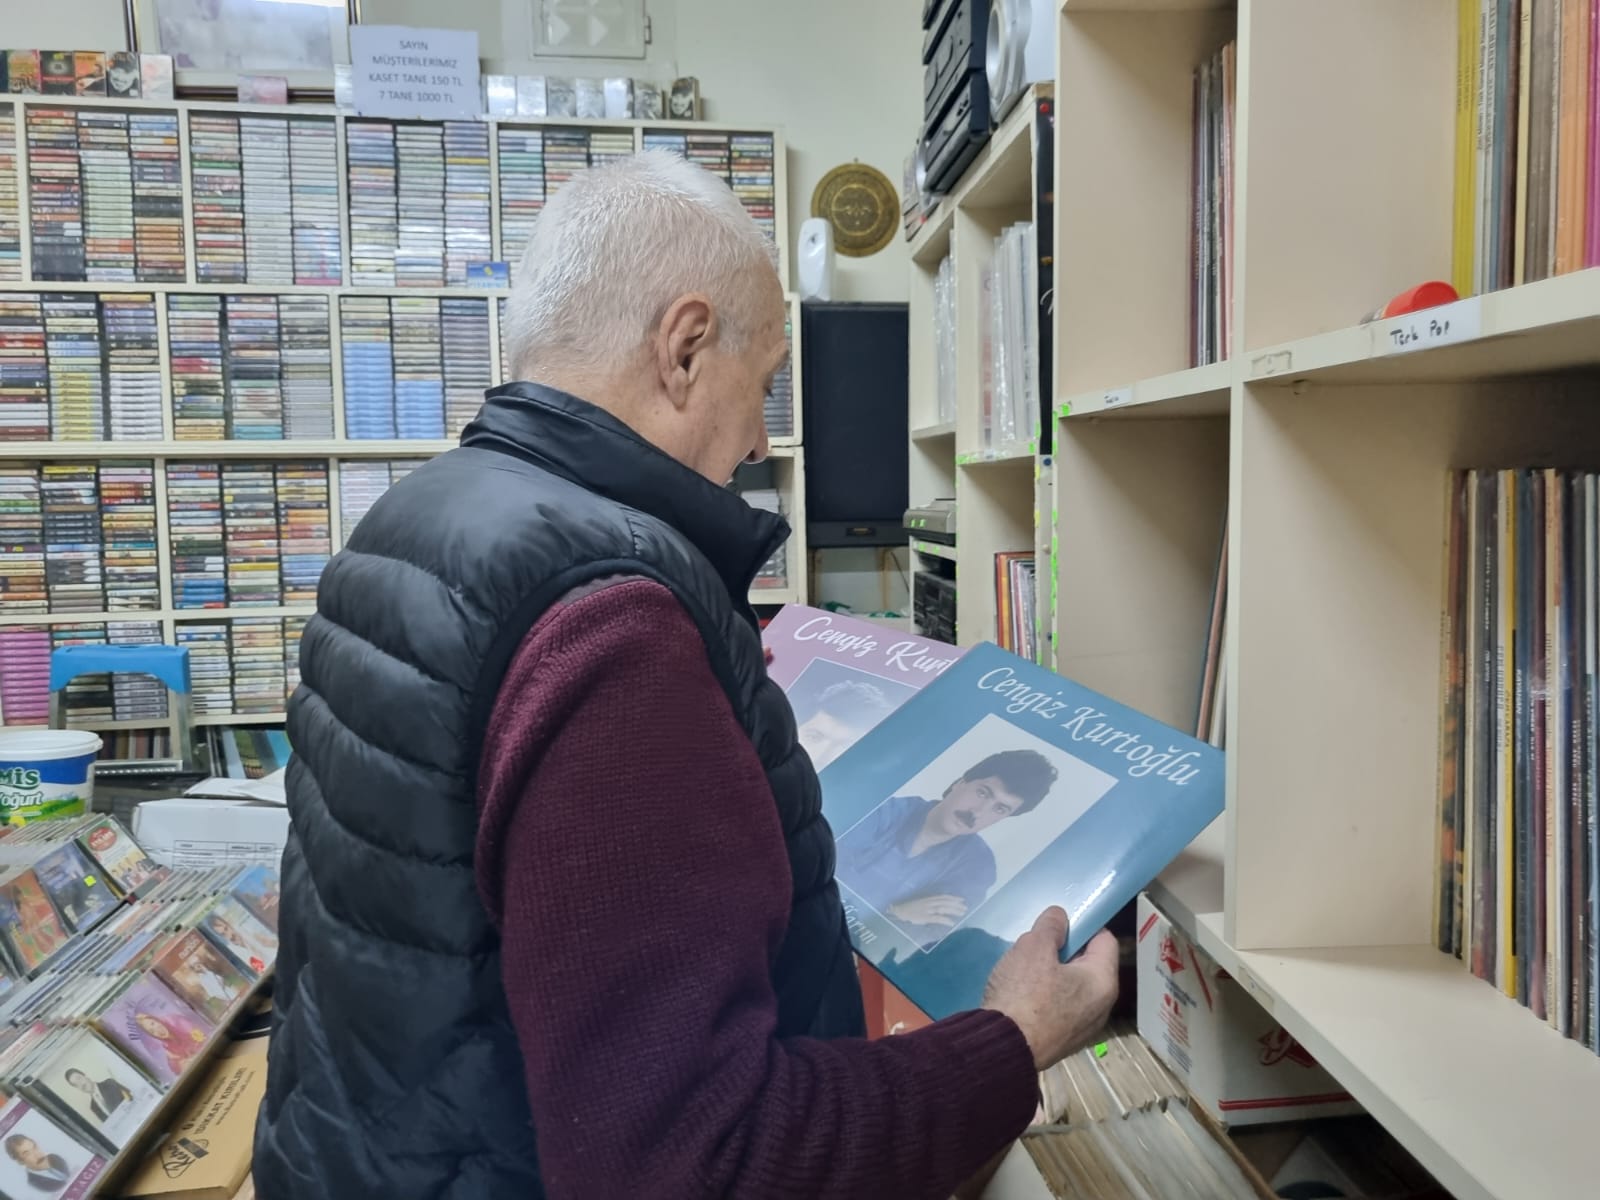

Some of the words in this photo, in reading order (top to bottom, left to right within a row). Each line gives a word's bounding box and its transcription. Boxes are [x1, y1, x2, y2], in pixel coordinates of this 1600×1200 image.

[399, 40, 429, 51] SAYIN
[368, 72, 399, 82] KASET
[402, 73, 428, 85] TANE
[431, 75, 450, 86] 150
[452, 76, 464, 87] TL
[388, 90, 413, 101] TANE
[417, 92, 442, 102] 1000
[444, 93, 455, 103] TL
[793, 616, 879, 658] Cengiz
[976, 666, 1068, 720] Cengiz
[1061, 706, 1202, 786] Kurtoğlu
[0, 790, 44, 811] oğurt
